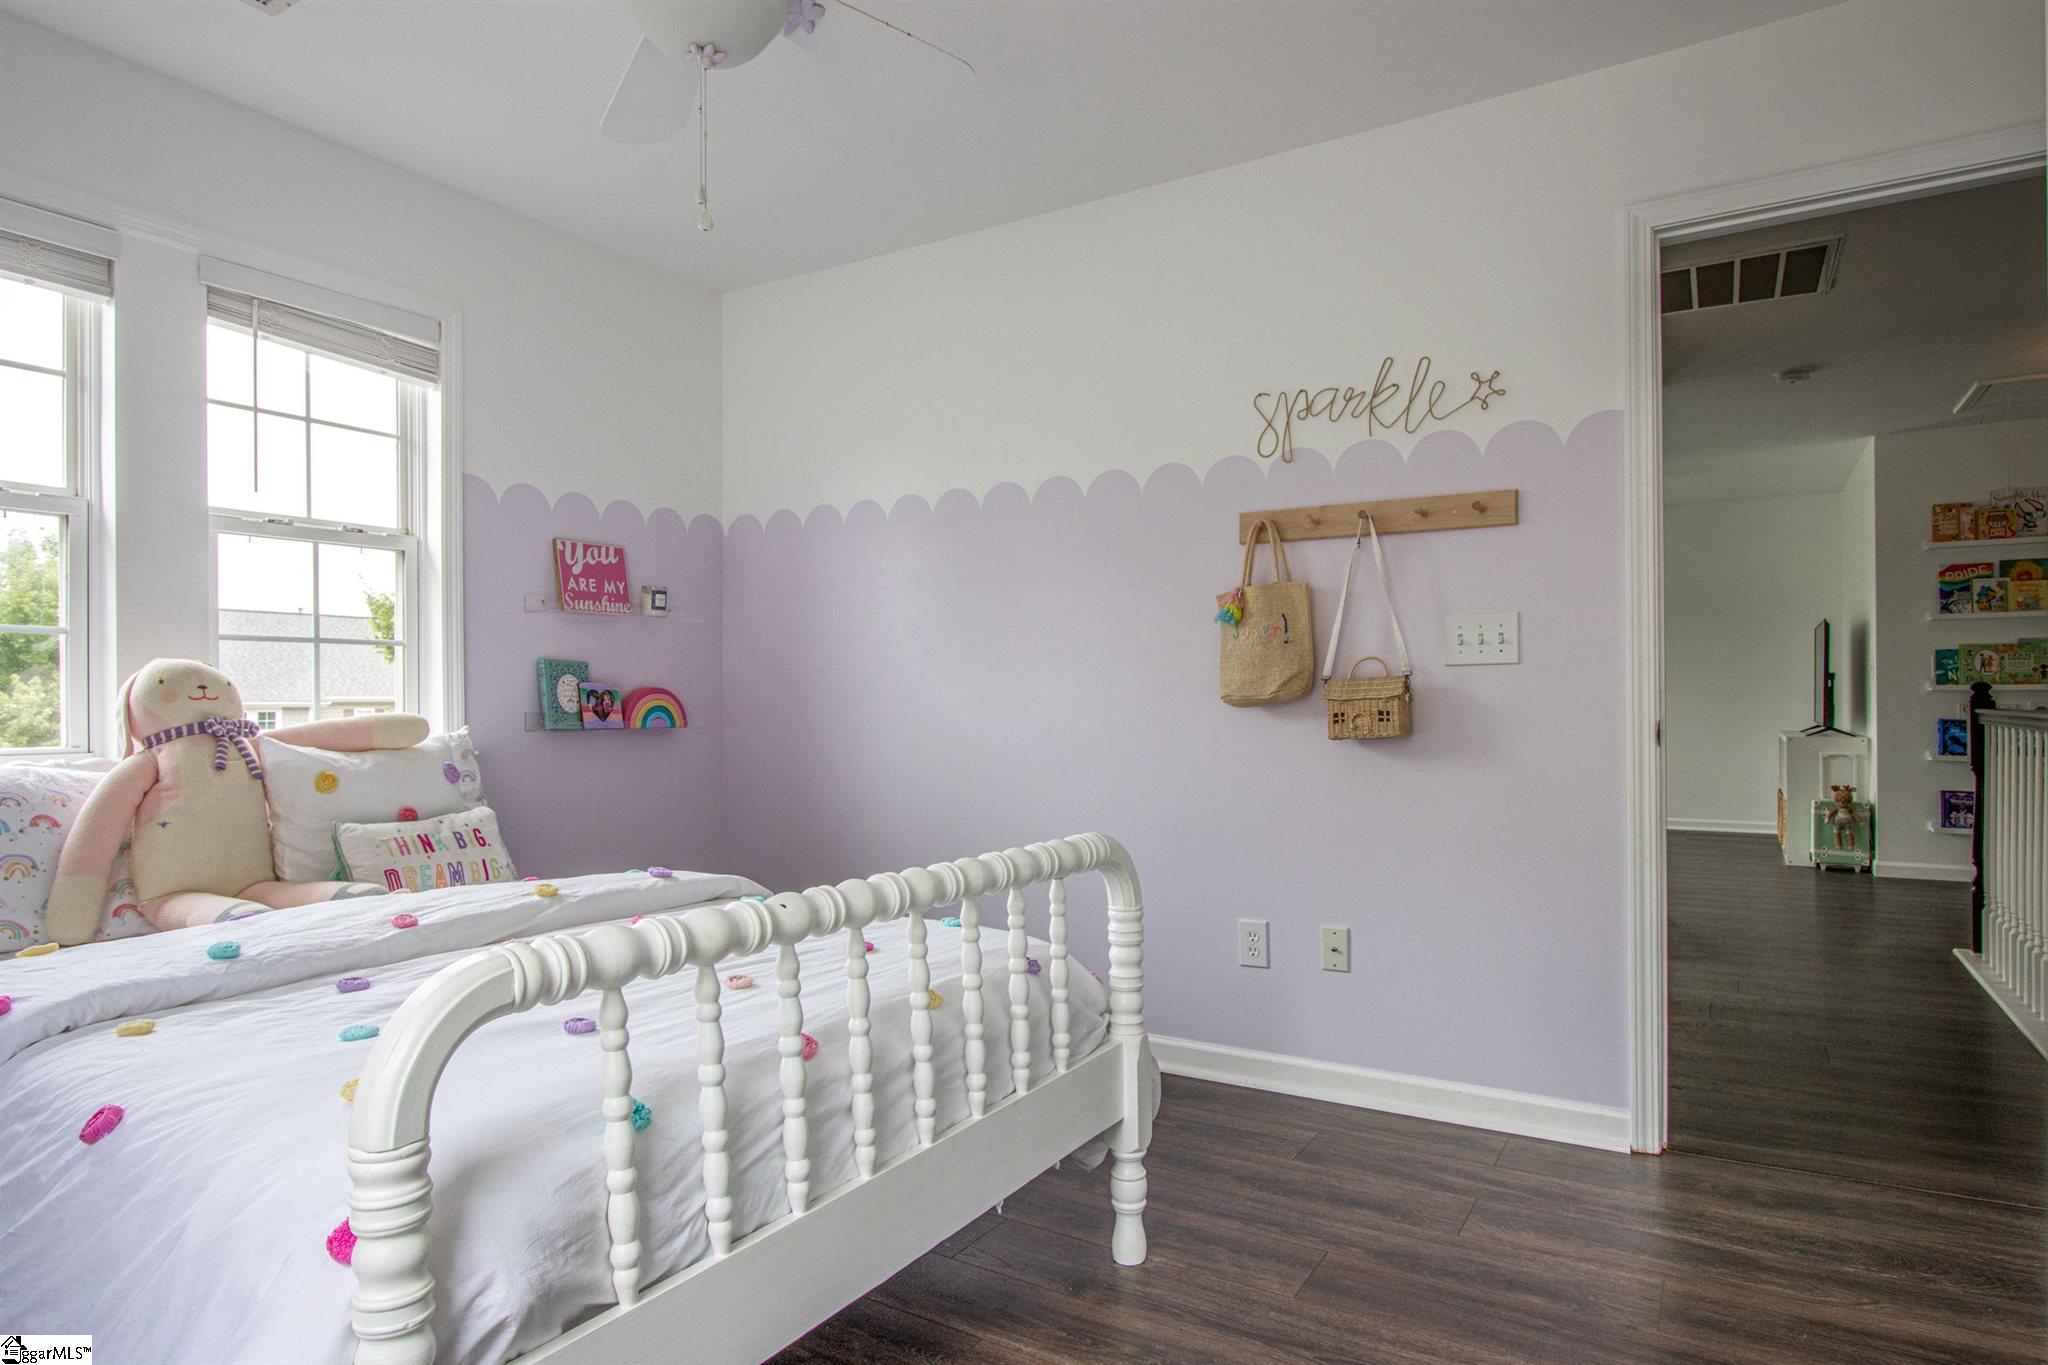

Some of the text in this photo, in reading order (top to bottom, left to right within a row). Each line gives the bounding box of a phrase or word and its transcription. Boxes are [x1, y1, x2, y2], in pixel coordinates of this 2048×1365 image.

[1253, 356, 1475, 463] sparkle
[557, 540, 619, 574] You
[568, 577, 625, 594] ARE MY
[1946, 565, 1987, 581] PRIDE
[565, 592, 632, 614] Sunshine
[378, 832, 448, 857] THINK
[384, 861, 466, 893] DREAM
